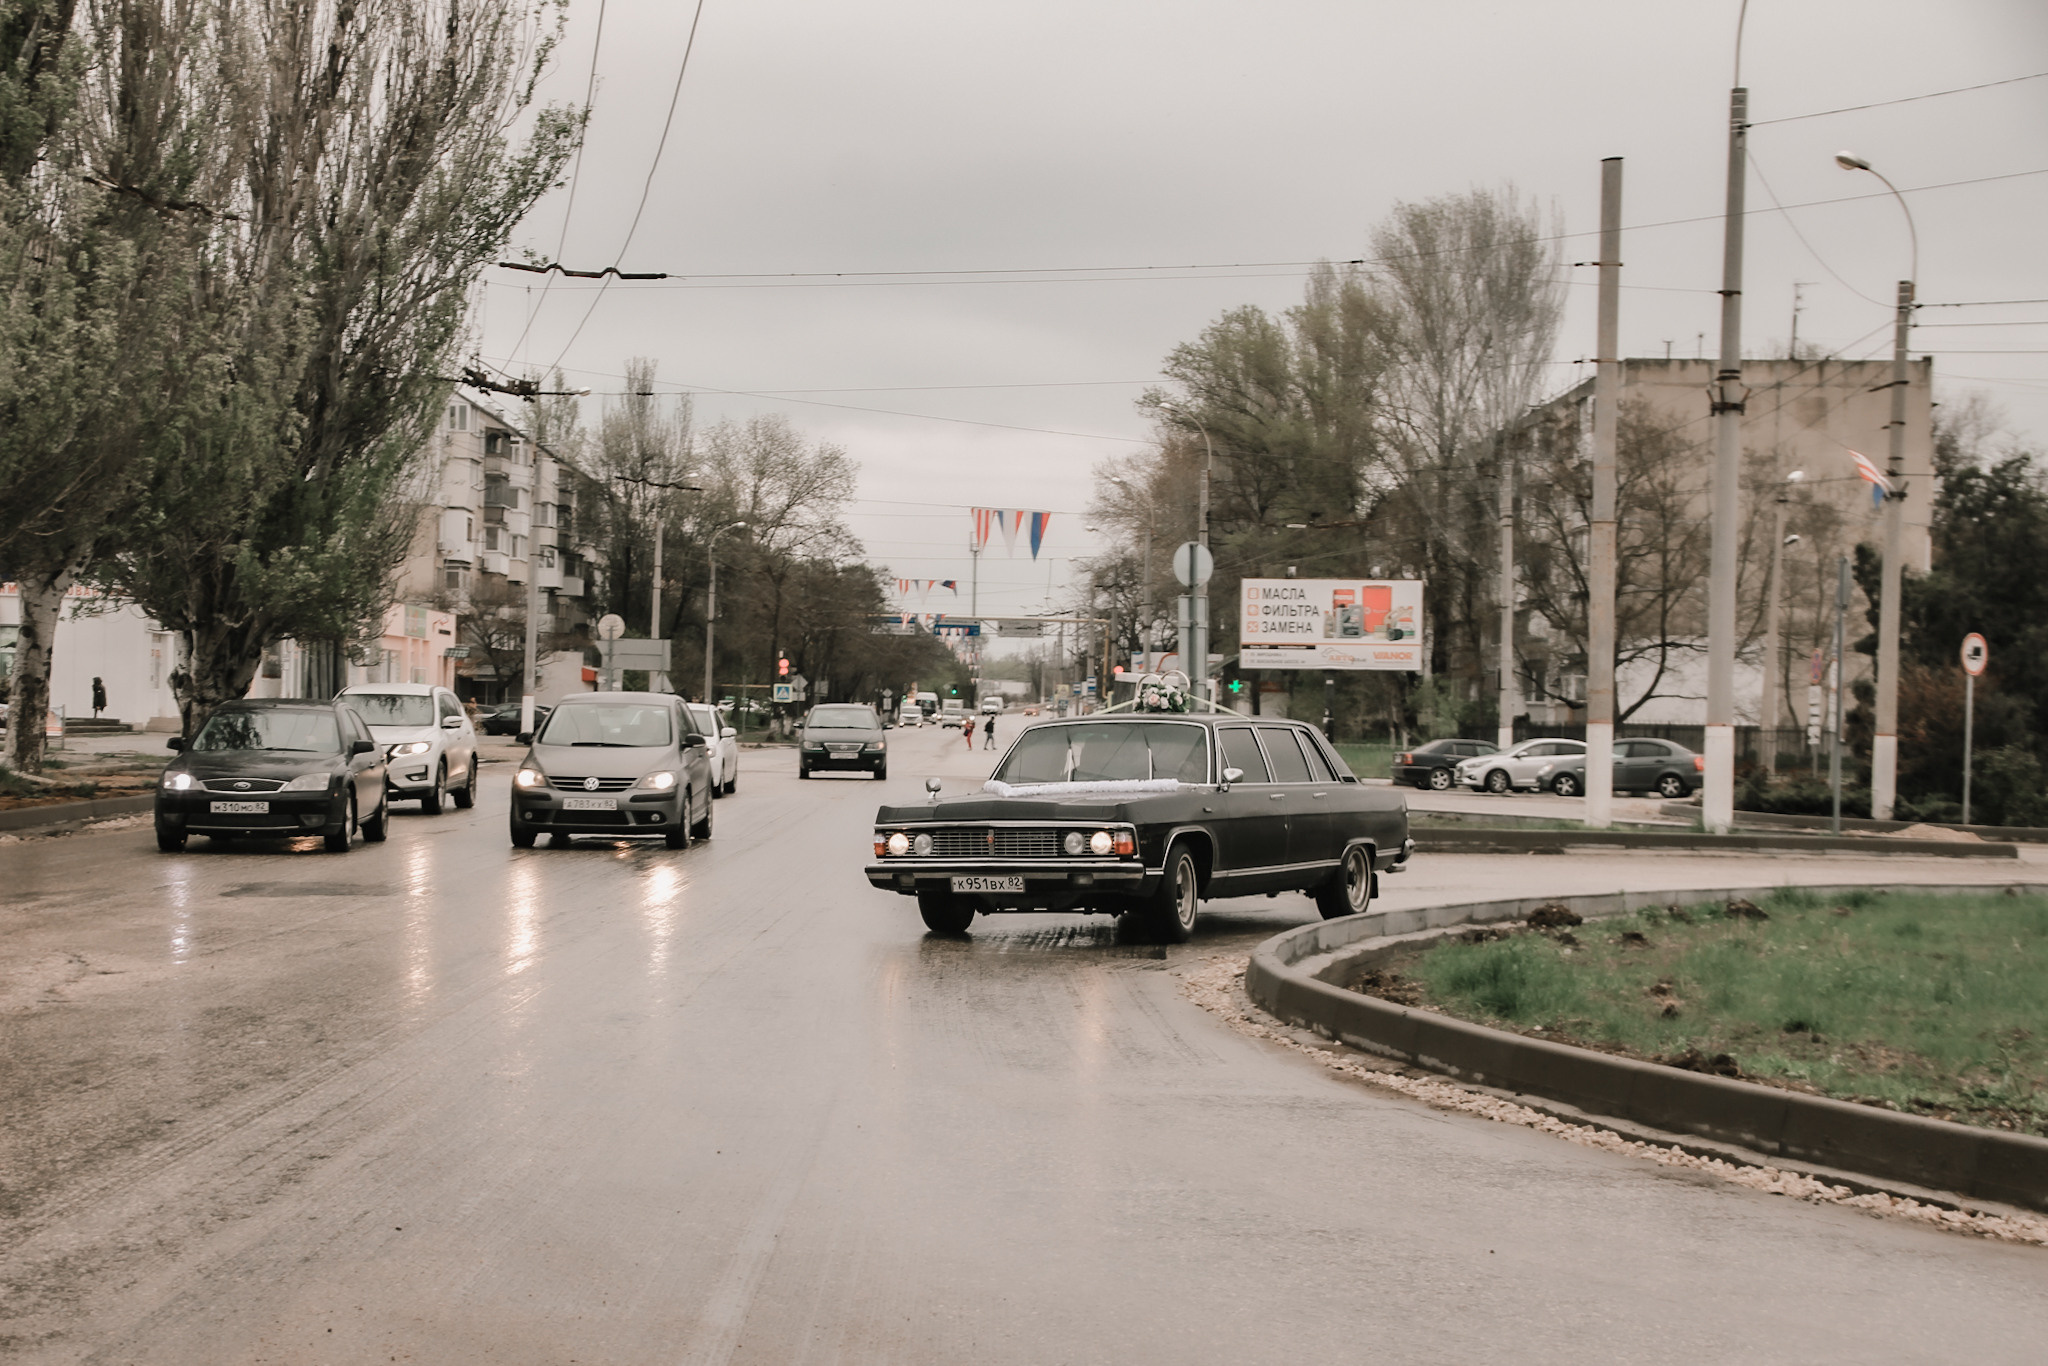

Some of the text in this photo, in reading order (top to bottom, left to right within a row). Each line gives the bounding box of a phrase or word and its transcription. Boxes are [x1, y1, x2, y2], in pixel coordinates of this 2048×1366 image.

[1262, 587, 1306, 600] МАСЛА
[1262, 604, 1320, 617] ФИЛЬТРА
[1261, 621, 1314, 633] ЗАМЕНА
[957, 877, 1020, 890] К951ВХ 82
